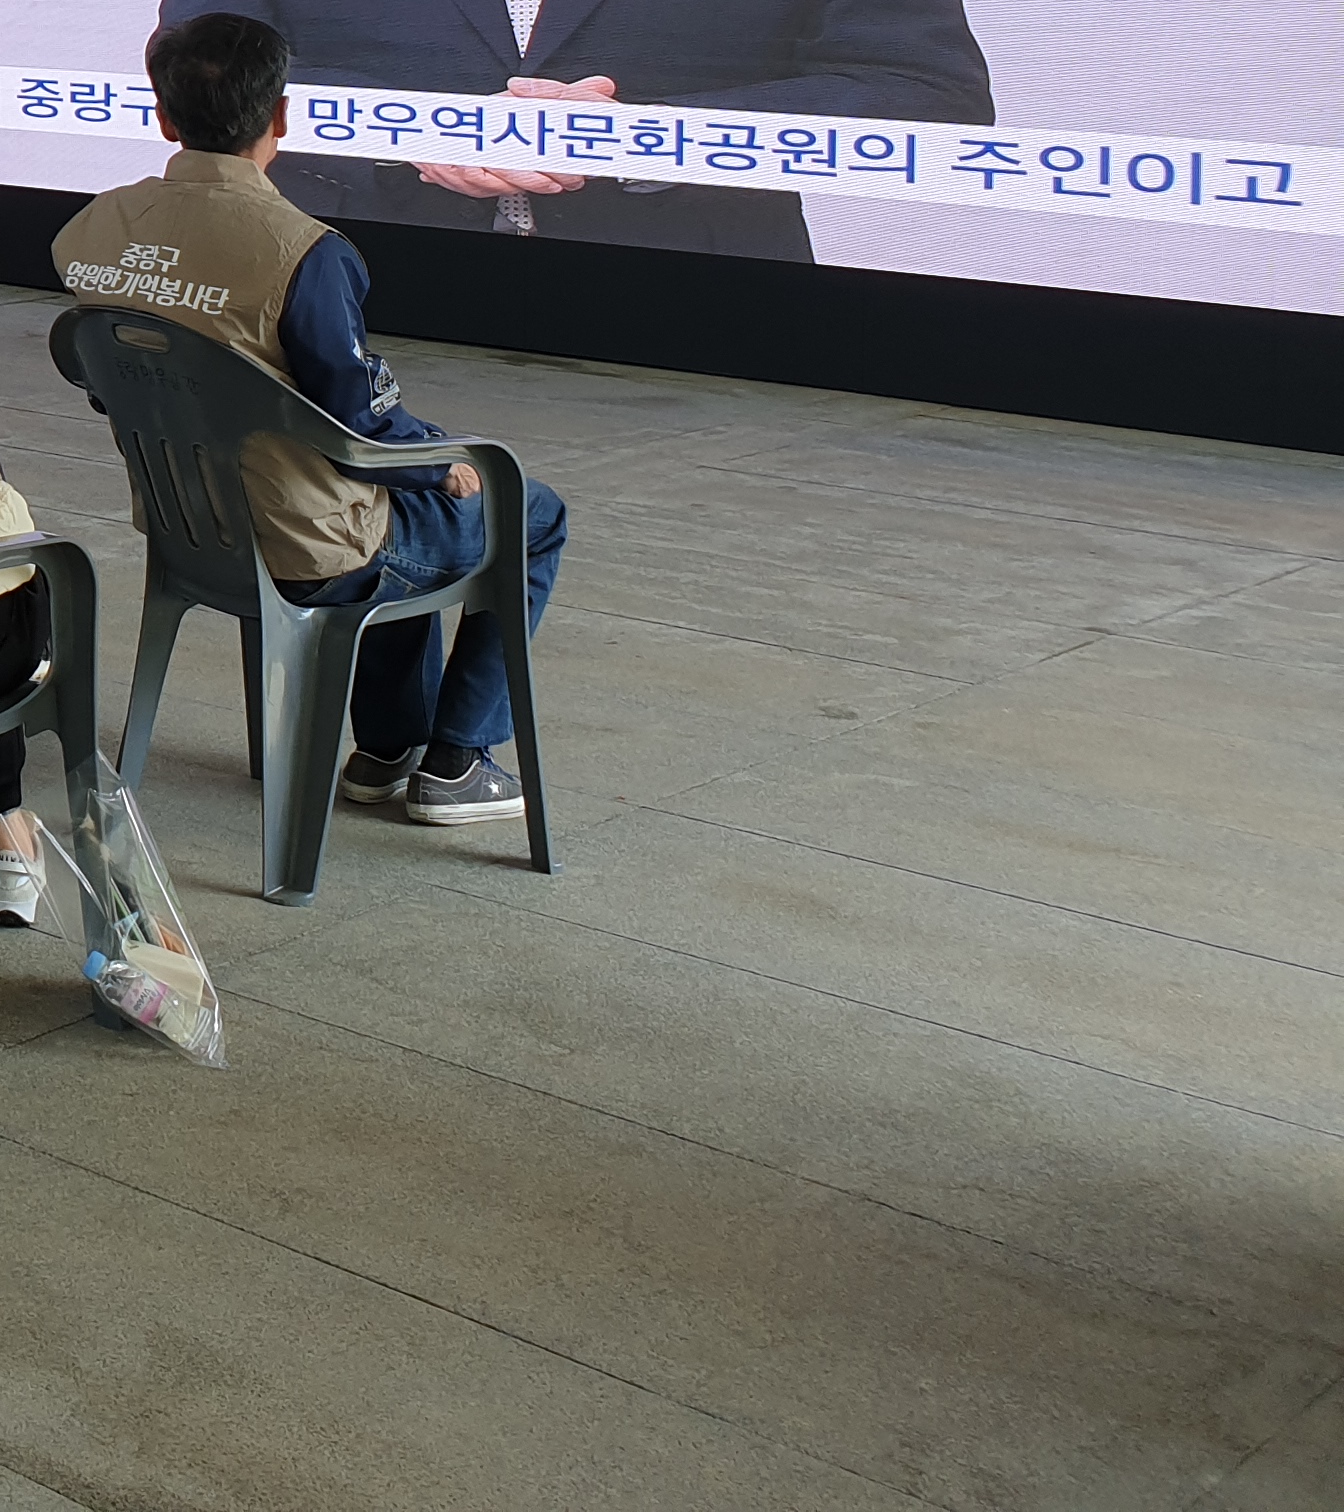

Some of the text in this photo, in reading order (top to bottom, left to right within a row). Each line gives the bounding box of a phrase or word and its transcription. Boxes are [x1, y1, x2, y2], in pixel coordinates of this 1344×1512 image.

[307, 97, 916, 185] 망우역사문화공원의
[950, 138, 1304, 206] 주인이고
[119, 242, 181, 273] 중랑구
[65, 260, 230, 315] 영원한기억봉사단
